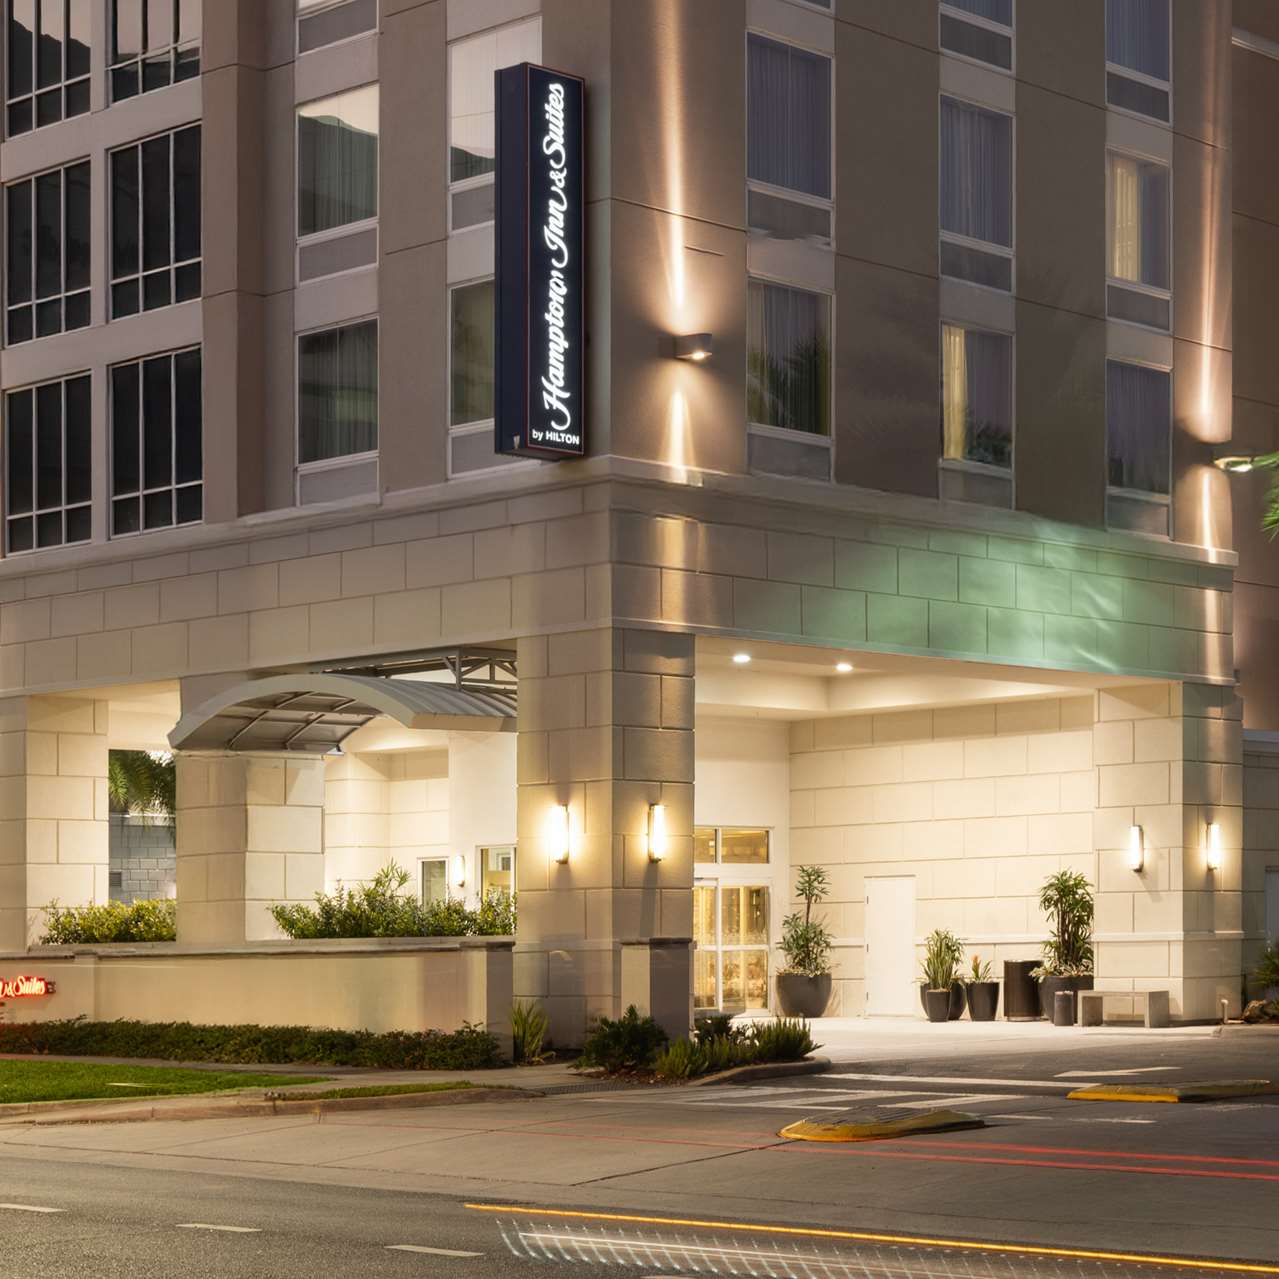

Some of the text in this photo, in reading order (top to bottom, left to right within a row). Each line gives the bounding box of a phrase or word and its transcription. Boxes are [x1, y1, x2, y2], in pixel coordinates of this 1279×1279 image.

[541, 82, 571, 431] Hampton Inn & Suites
[532, 428, 580, 445] by HILTON
[13, 975, 46, 996] Suites
